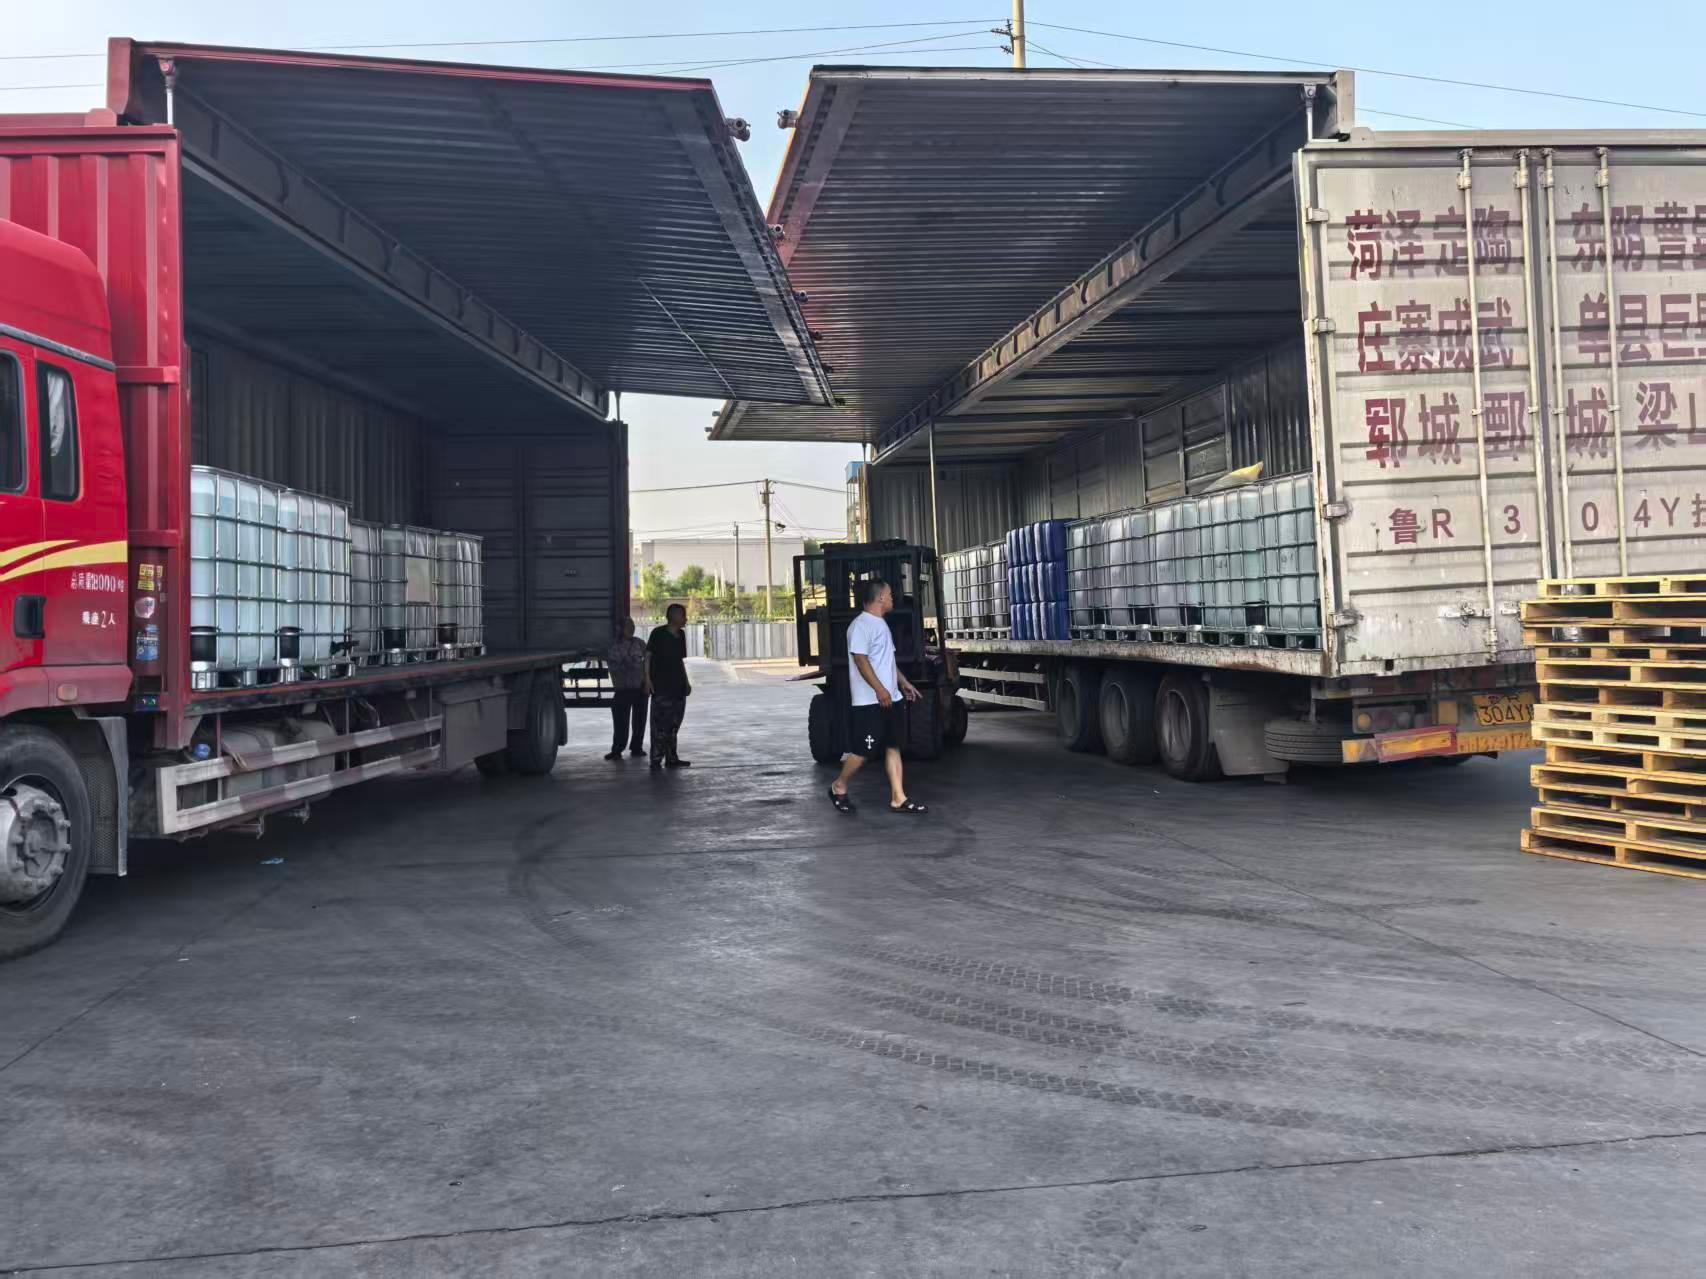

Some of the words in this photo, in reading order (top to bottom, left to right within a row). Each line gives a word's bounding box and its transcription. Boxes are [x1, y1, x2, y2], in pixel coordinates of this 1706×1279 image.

[1345, 205, 1512, 281] 菏泽定陶
[1357, 297, 1513, 374] 庄寨成武
